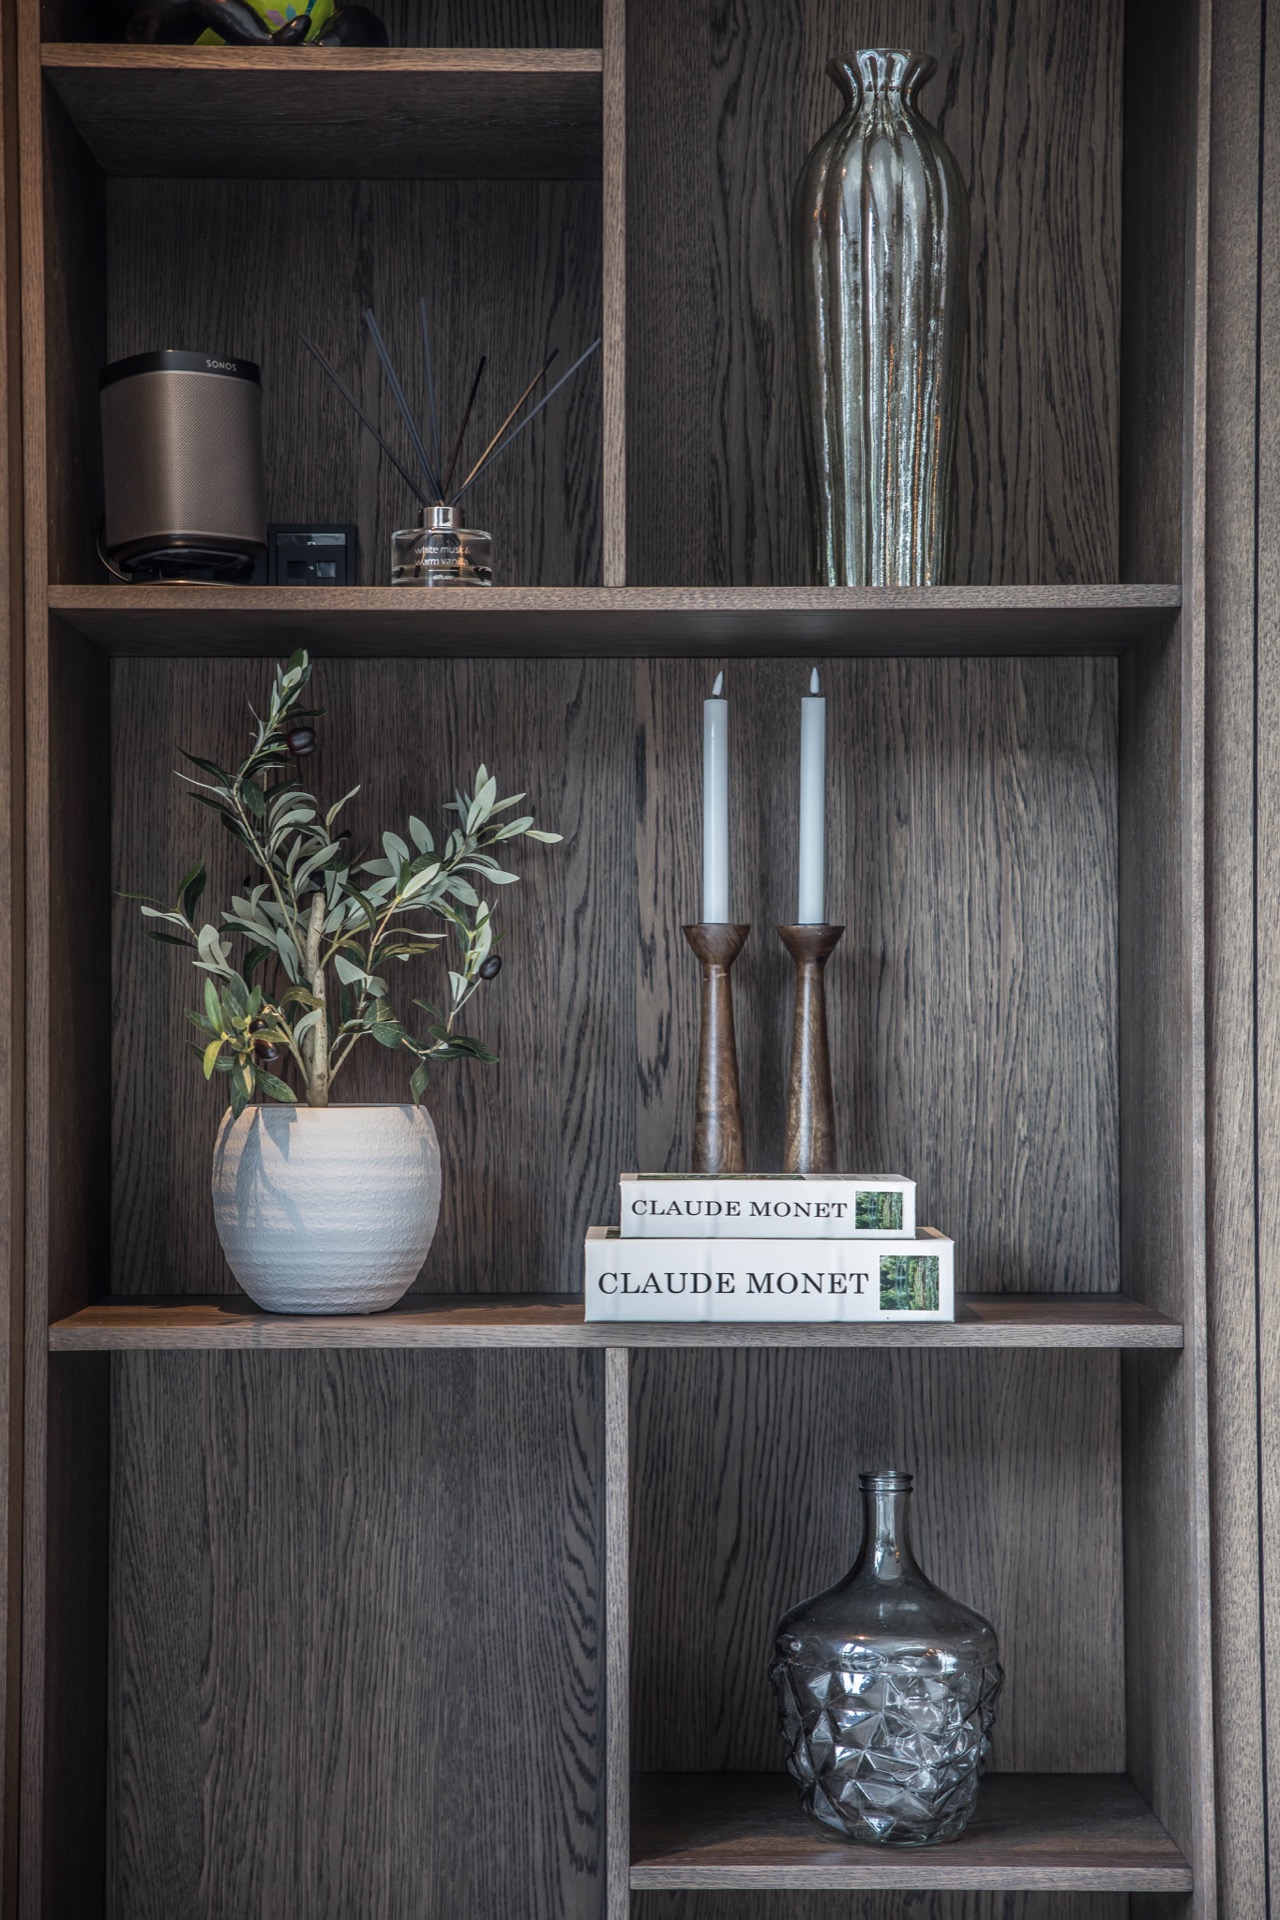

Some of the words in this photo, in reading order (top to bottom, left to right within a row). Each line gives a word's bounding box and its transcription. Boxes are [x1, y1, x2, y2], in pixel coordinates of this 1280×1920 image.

[206, 359, 237, 371] SONOS
[415, 546, 438, 554] white
[415, 557, 440, 566] warm
[631, 1199, 741, 1217] CLAUDE
[749, 1201, 848, 1218] MONET
[598, 1272, 736, 1295] CLAUDE
[745, 1272, 869, 1295] MONET
